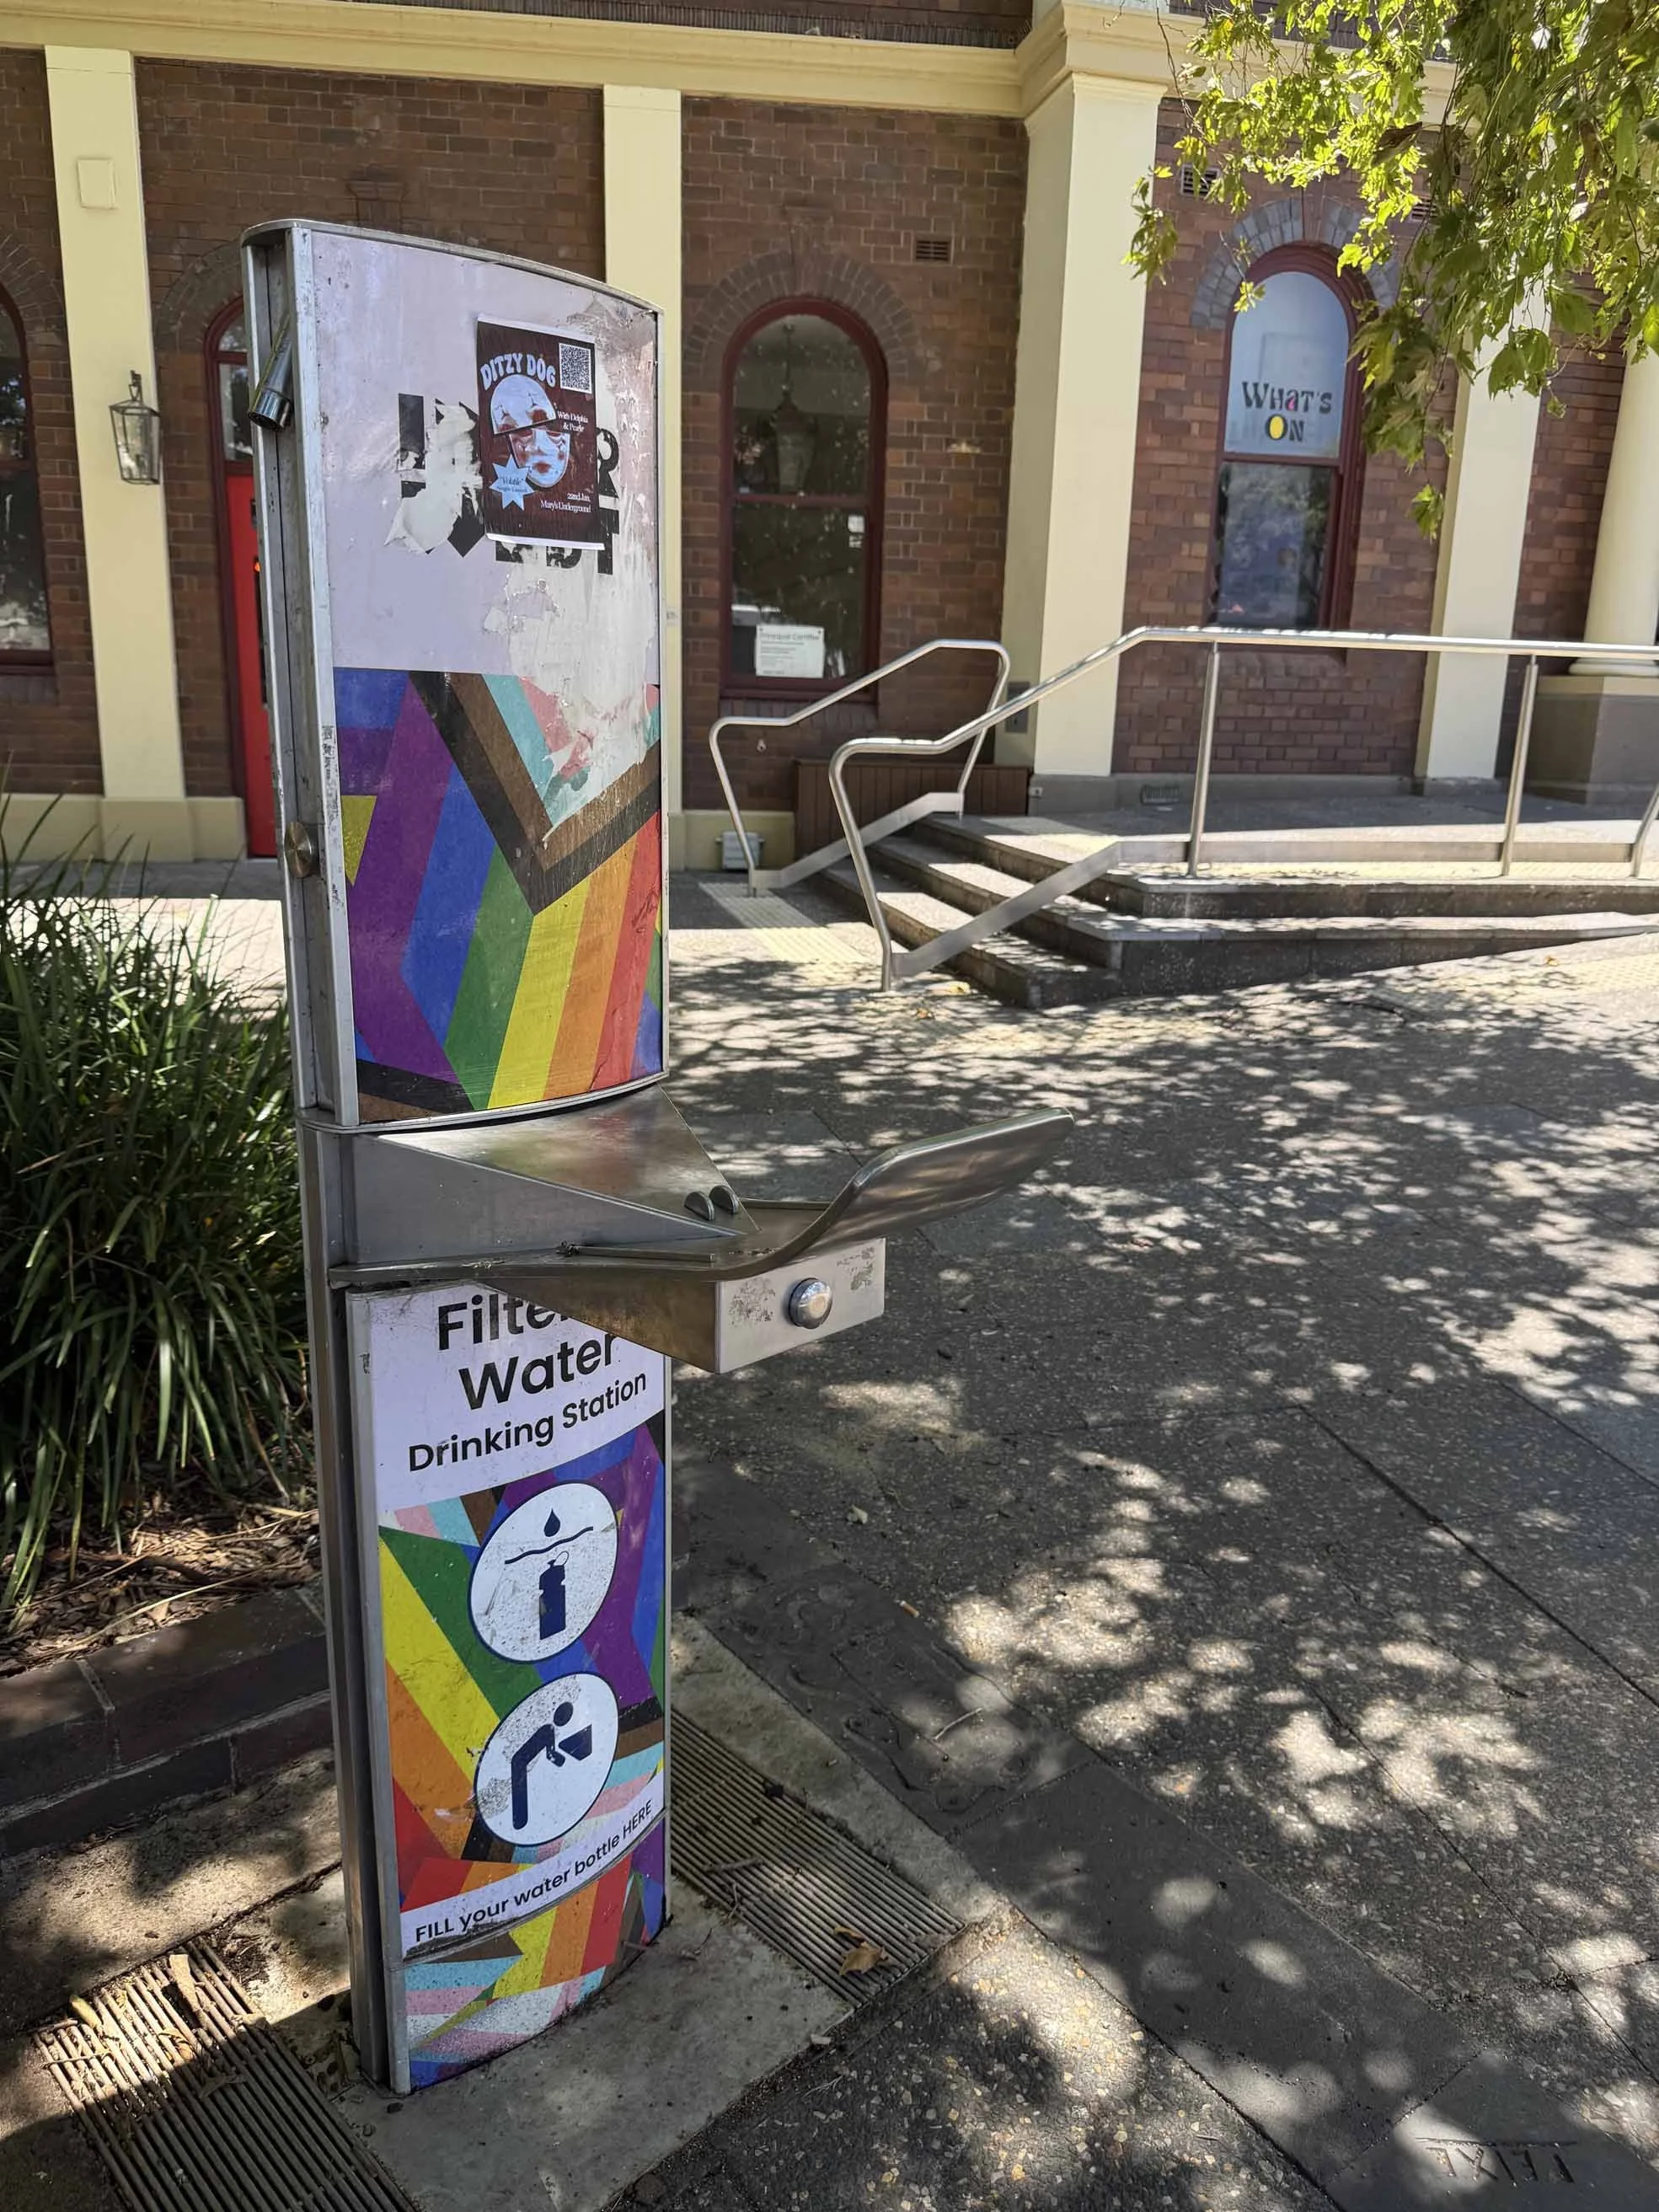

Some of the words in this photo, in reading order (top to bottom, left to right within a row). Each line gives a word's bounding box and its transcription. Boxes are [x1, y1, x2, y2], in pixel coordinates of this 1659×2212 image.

[480, 352, 522, 390] DITZY
[526, 353, 556, 388] DOG
[557, 410, 570, 420] With
[563, 421, 569, 430] &
[438, 1293, 573, 1351] Filte
[458, 1333, 618, 1411] Water
[409, 1415, 554, 1471] Drinking
[562, 1373, 646, 1429] Station
[415, 1917, 455, 1942] FILL
[459, 1899, 509, 1932] your
[514, 1869, 572, 1906] water
[575, 1834, 620, 1877] bottle
[622, 1799, 653, 1840] HERE
